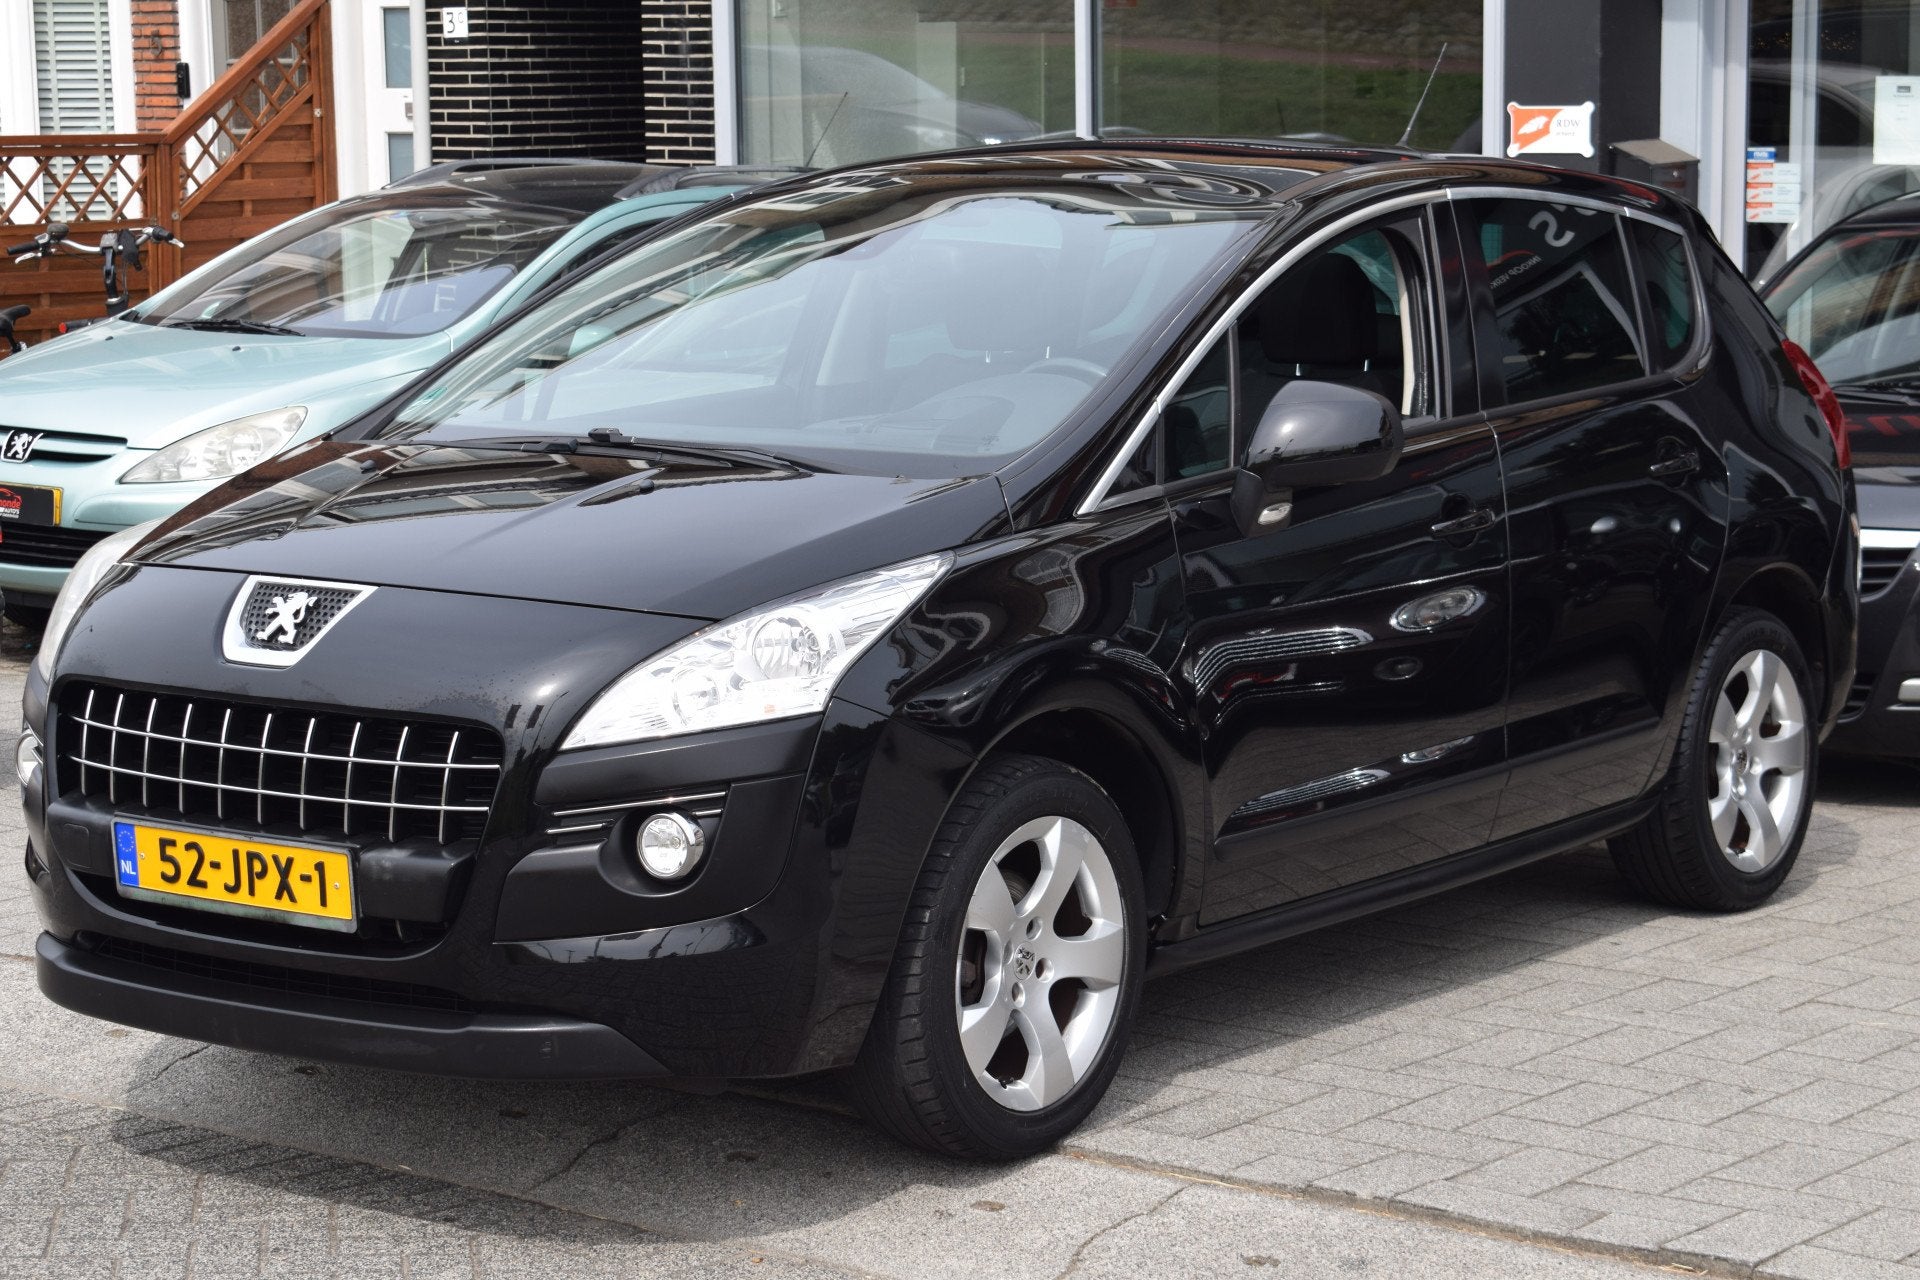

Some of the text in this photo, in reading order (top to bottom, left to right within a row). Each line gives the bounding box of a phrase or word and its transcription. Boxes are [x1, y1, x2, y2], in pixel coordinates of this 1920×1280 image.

[1556, 119, 1581, 128] RDW
[120, 859, 137, 876] NL
[158, 837, 328, 908] 52-JPX-1
